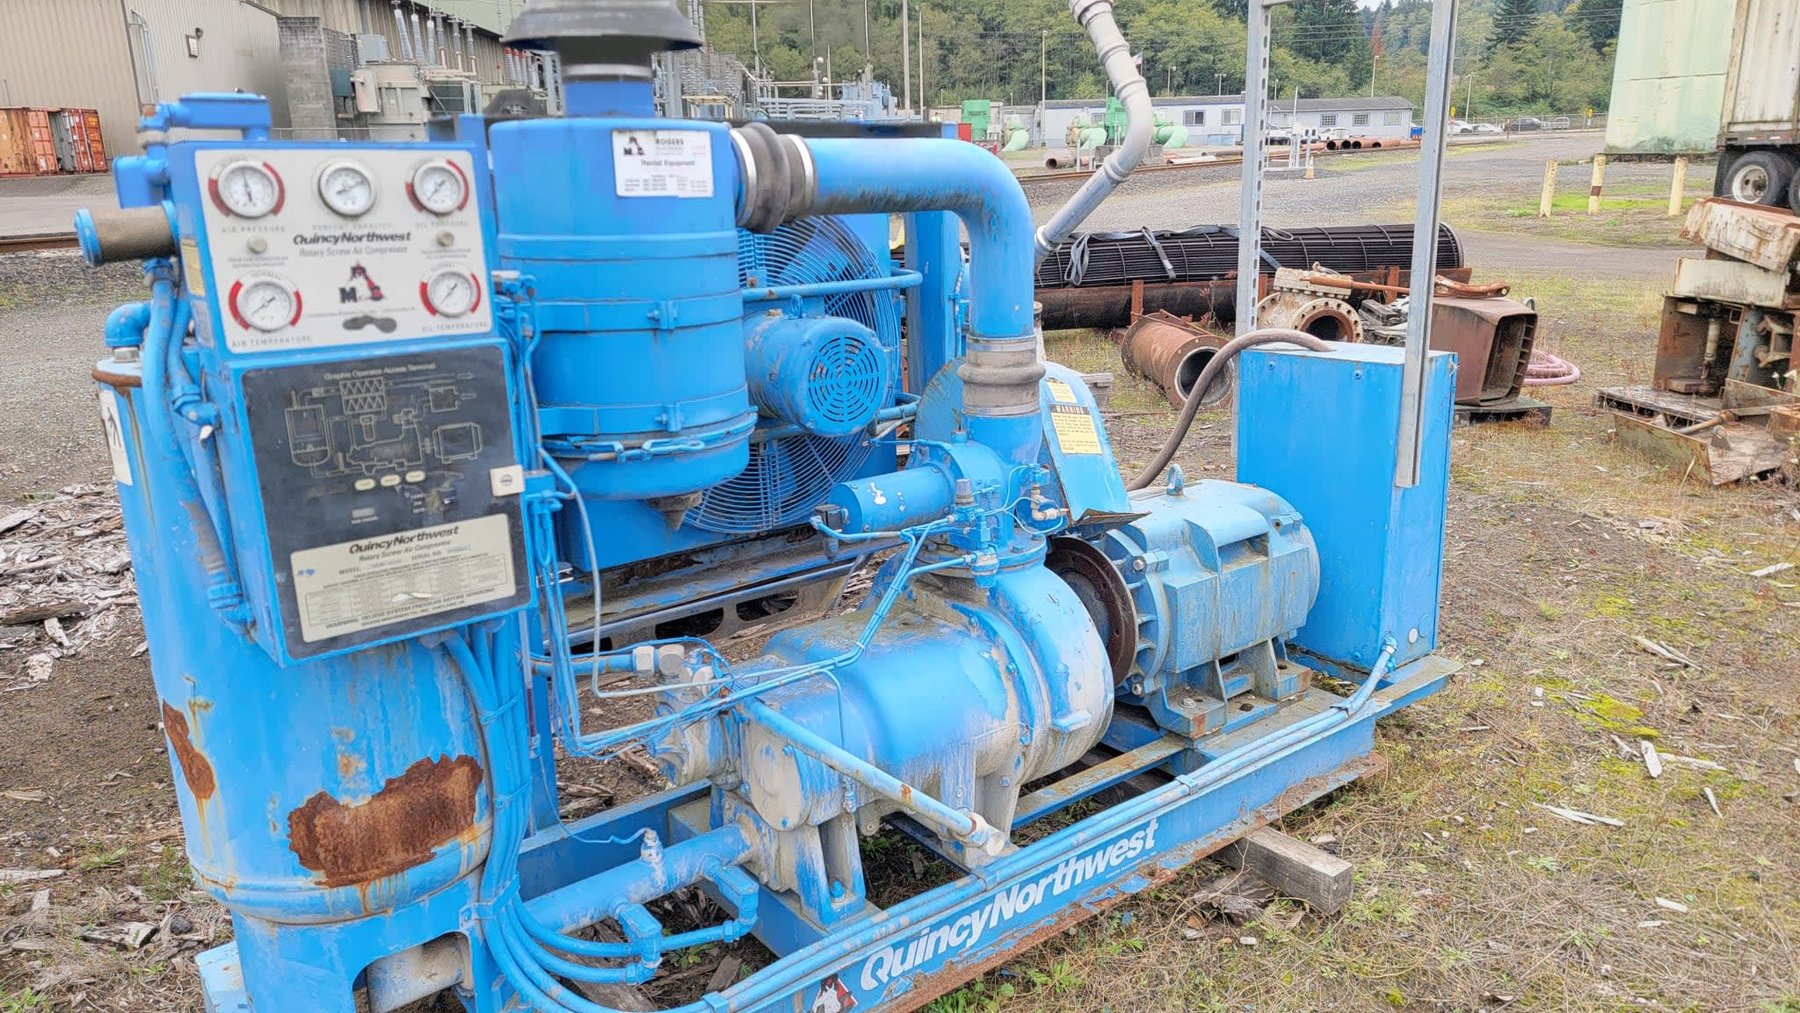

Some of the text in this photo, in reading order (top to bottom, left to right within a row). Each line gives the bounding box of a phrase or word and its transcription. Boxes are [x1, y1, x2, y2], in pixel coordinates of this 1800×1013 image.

[655, 138, 684, 146] ROGERS
[664, 160, 695, 168] Equipment
[221, 225, 287, 233] AIR PRESSURE
[293, 231, 412, 246] QuincyNorthwest
[299, 245, 408, 258] Rotary Screw Air Compressor
[435, 320, 489, 330] TEMPERATURE
[231, 335, 312, 348] AIR TEMPERATURE
[1056, 405, 1085, 414] WARNING
[349, 525, 460, 554] QuincyNorthwest
[358, 552, 381, 563] Rotary
[380, 549, 403, 559] Screw
[402, 547, 414, 556] Air
[414, 540, 452, 553] Compressor
[859, 817, 1160, 992] QuincyNorthwest
